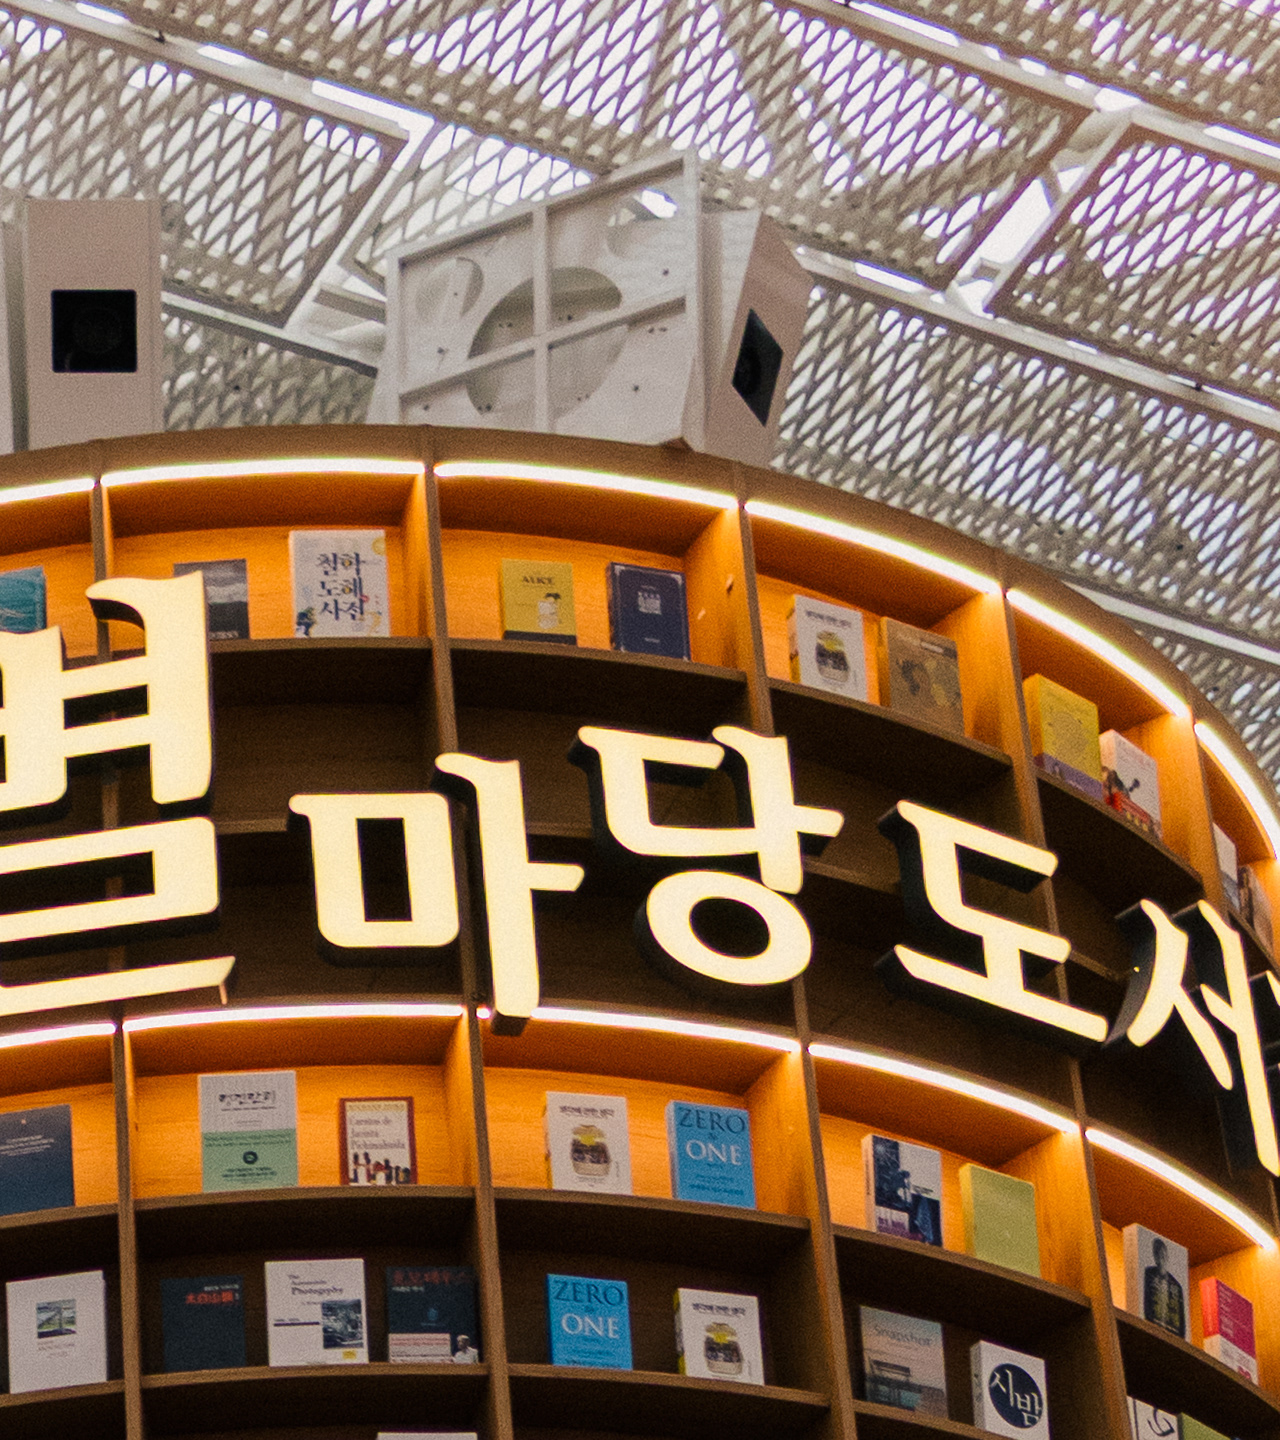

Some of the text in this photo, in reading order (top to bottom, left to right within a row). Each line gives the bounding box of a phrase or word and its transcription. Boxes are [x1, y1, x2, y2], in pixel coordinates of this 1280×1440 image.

[679, 1107, 745, 1135] ZERO
[686, 1140, 743, 1166] ONE
[553, 1279, 625, 1307] ZERO
[560, 1314, 620, 1341] ONE
